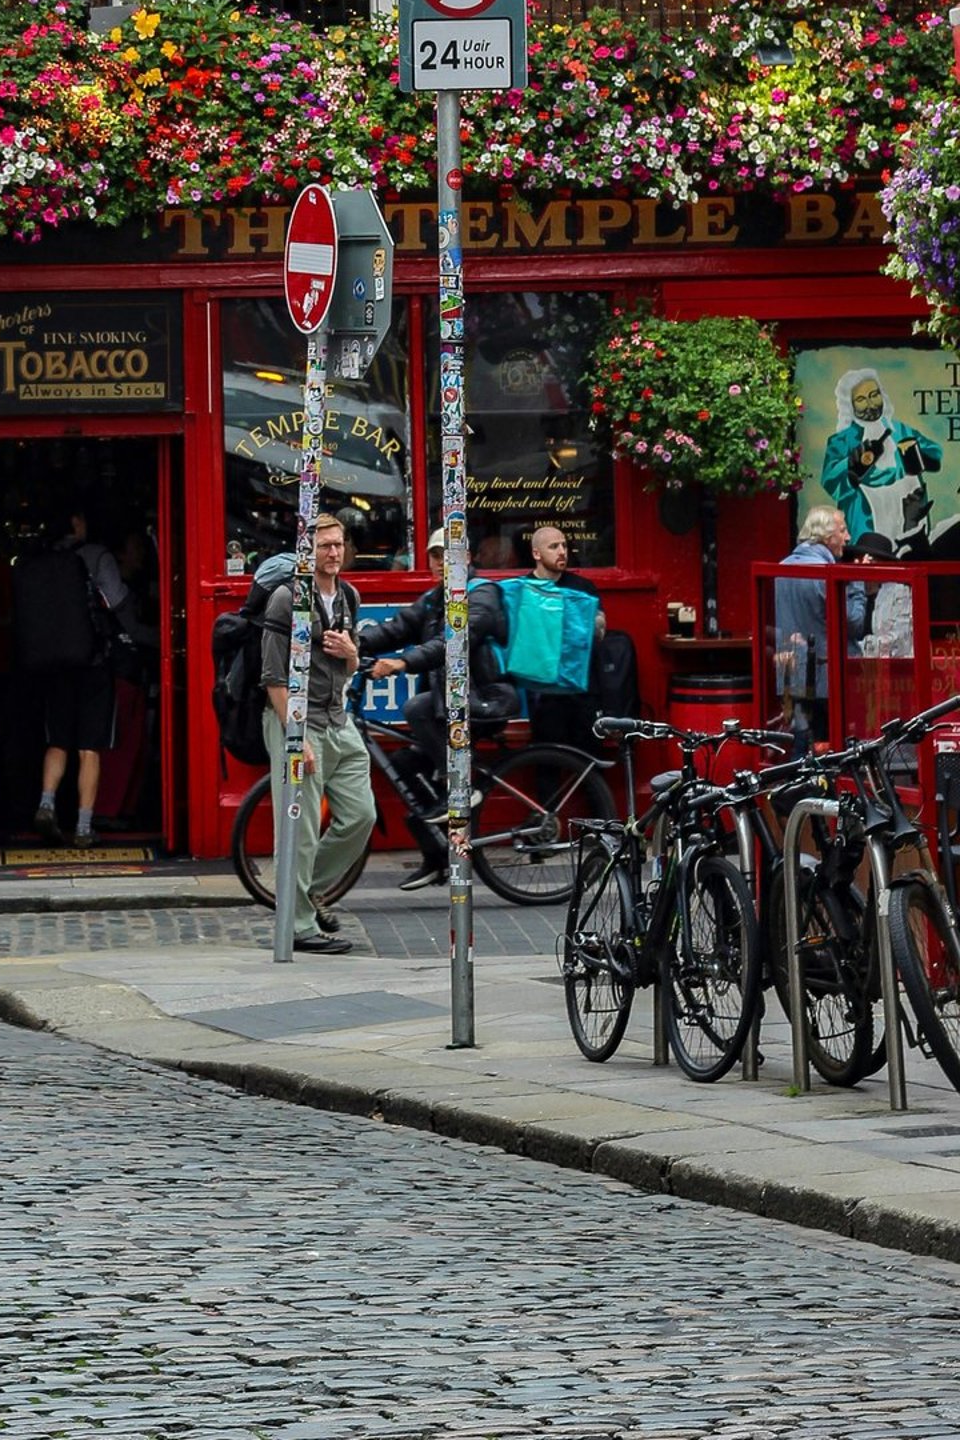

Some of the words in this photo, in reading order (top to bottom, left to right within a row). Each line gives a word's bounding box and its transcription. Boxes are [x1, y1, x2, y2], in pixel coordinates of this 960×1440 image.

[462, 39, 491, 52] Uair
[418, 39, 461, 70] 24
[463, 56, 505, 69] HOUR
[164, 206, 289, 255] TH
[783, 192, 889, 241] BA
[19, 324, 36, 336] OF
[43, 332, 77, 345] FINE
[79, 331, 147, 345] SMOKING
[22, 385, 82, 398] Always
[92, 384, 107, 397] in
[112, 383, 162, 397] Stock
[299, 384, 335, 398] TE
[234, 410, 340, 459] TEMPE
[350, 415, 401, 461] BAR
[490, 476, 520, 489] lived
[522, 476, 550, 489] and
[549, 476, 585, 489] loved
[479, 495, 530, 512] laughed
[529, 495, 554, 509] and
[534, 520, 561, 529] JAMES
[561, 520, 587, 529] JOYCE
[574, 533, 598, 541] WAKE
